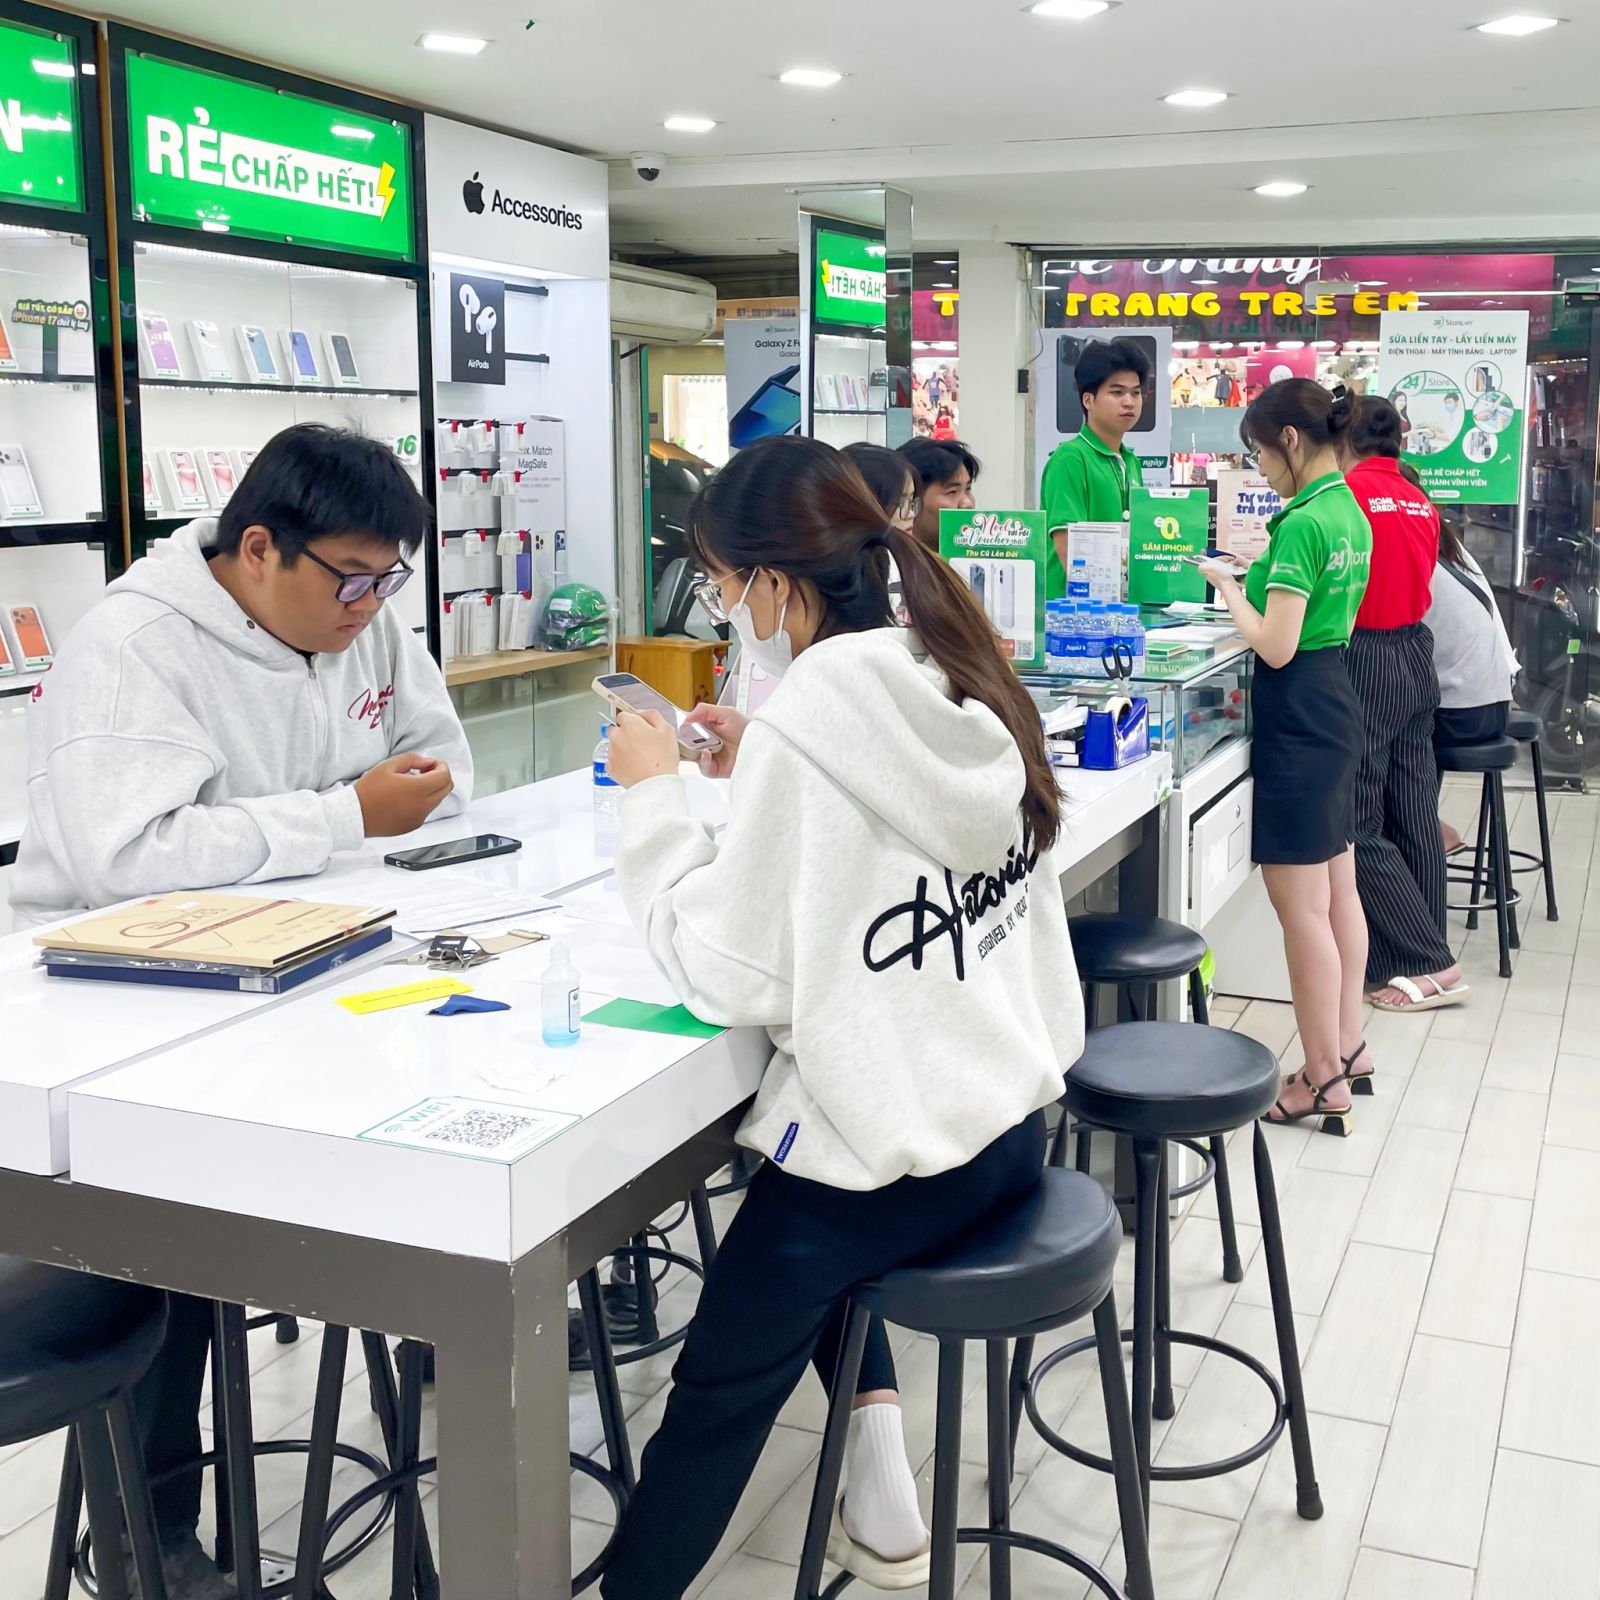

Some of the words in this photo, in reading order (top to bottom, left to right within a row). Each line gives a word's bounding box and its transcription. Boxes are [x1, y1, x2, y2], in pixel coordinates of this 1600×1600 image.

[147, 106, 226, 187] RẺ
[231, 153, 310, 194] CHẤP
[317, 167, 375, 208] HẾT!
[491, 189, 583, 230] Accessories
[1065, 292, 1221, 317] TRANG
[1353, 291, 1420, 316] EM
[47, 315, 58, 326] 17
[754, 340, 786, 349] Galaxy
[1431, 335, 1448, 344] TAY
[1496, 333, 1517, 343] MÁY
[1431, 347, 1447, 355] MÁY
[1490, 348, 1518, 356] LAPTOP
[467, 358, 490, 371] AirPods
[1402, 376, 1420, 389] 24
[396, 434, 417, 456] 16
[532, 446, 553, 456] Match
[518, 458, 548, 471] MagSafe
[1142, 458, 1165, 468] ngày
[1420, 467, 1433, 476] GIÁ
[1257, 490, 1281, 502] vấn
[967, 528, 1010, 545] Voucher
[1162, 544, 1194, 552] IPHONE
[1326, 550, 1345, 570] 24
[1153, 563, 1168, 572] siêu
